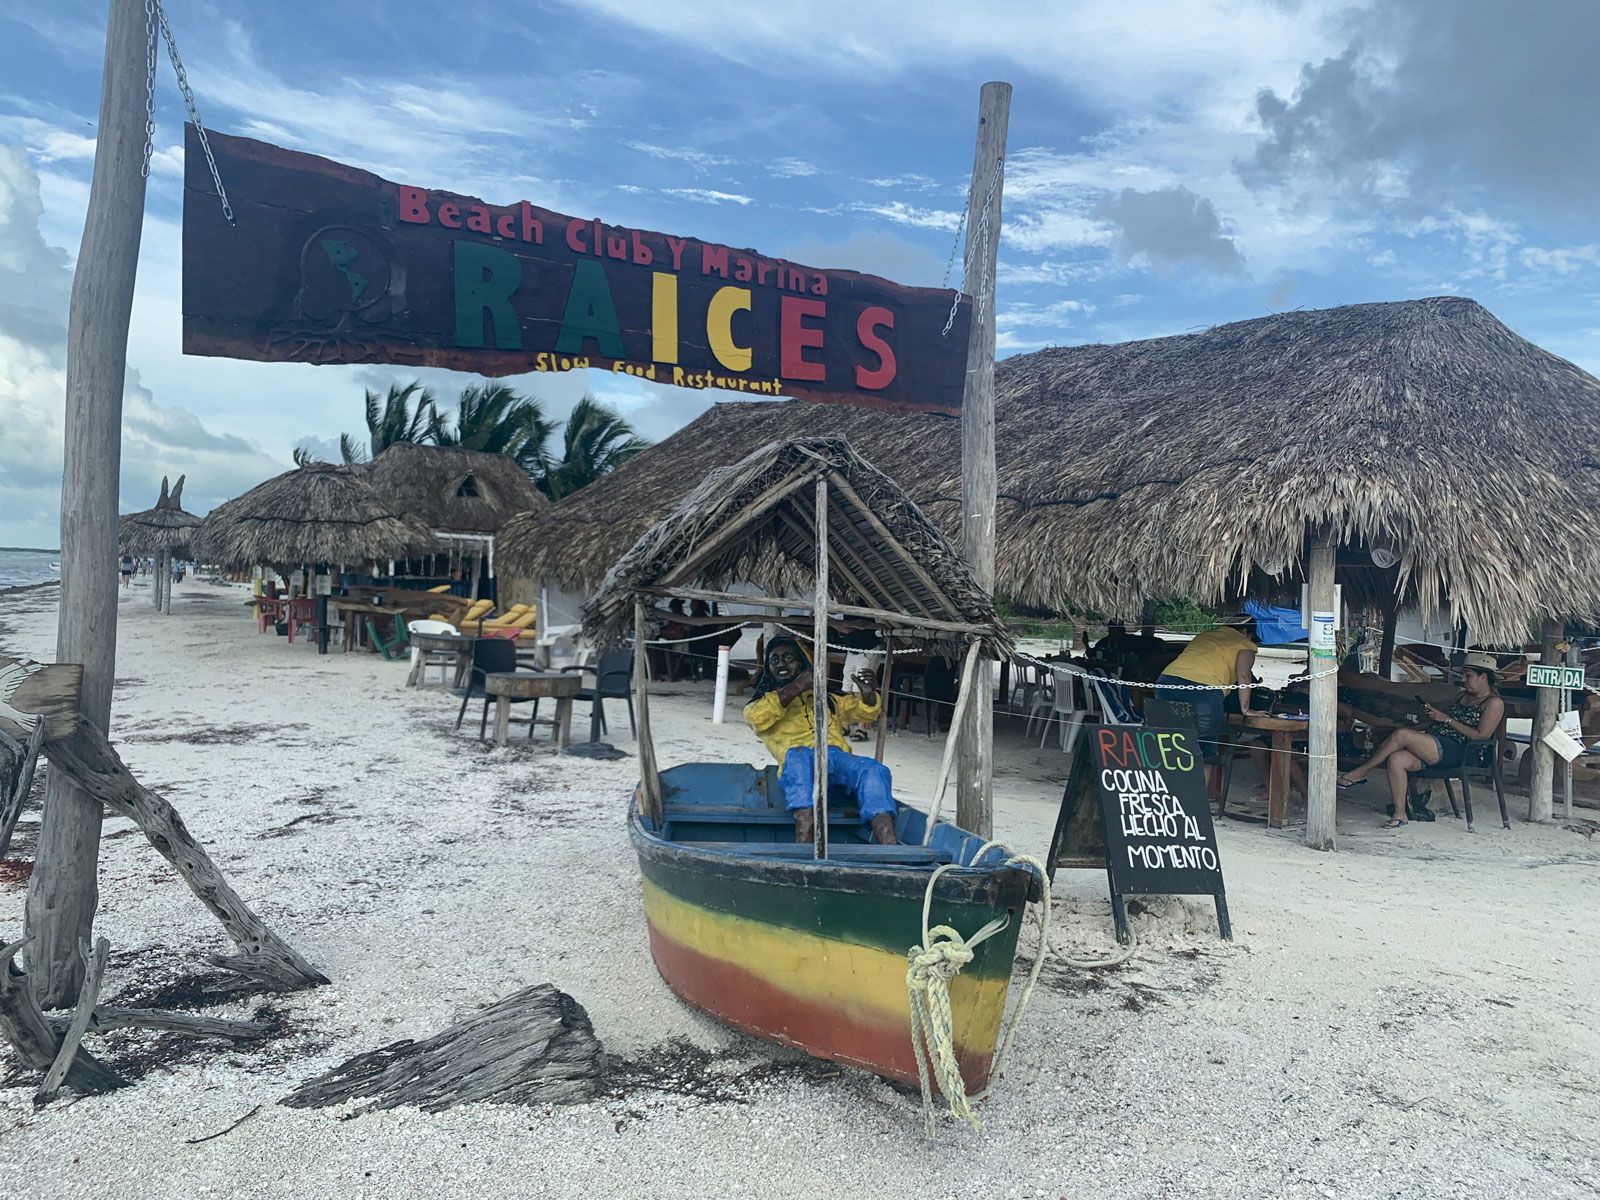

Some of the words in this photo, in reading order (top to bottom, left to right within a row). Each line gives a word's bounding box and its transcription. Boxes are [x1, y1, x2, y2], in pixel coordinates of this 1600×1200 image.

[399, 185, 544, 244] Beach
[565, 218, 653, 265] Club
[665, 237, 686, 270] Y
[702, 244, 828, 296] Marina
[452, 239, 897, 390] RAICES
[535, 352, 590, 372] Slow
[612, 361, 656, 380] Food
[673, 366, 783, 395] Restaurant
[1097, 729, 1195, 772] RAICES
[1101, 769, 1169, 794] COCINA
[1118, 793, 1186, 817] FRESCA
[1120, 814, 1178, 837] HECHO
[1184, 815, 1207, 841] AL
